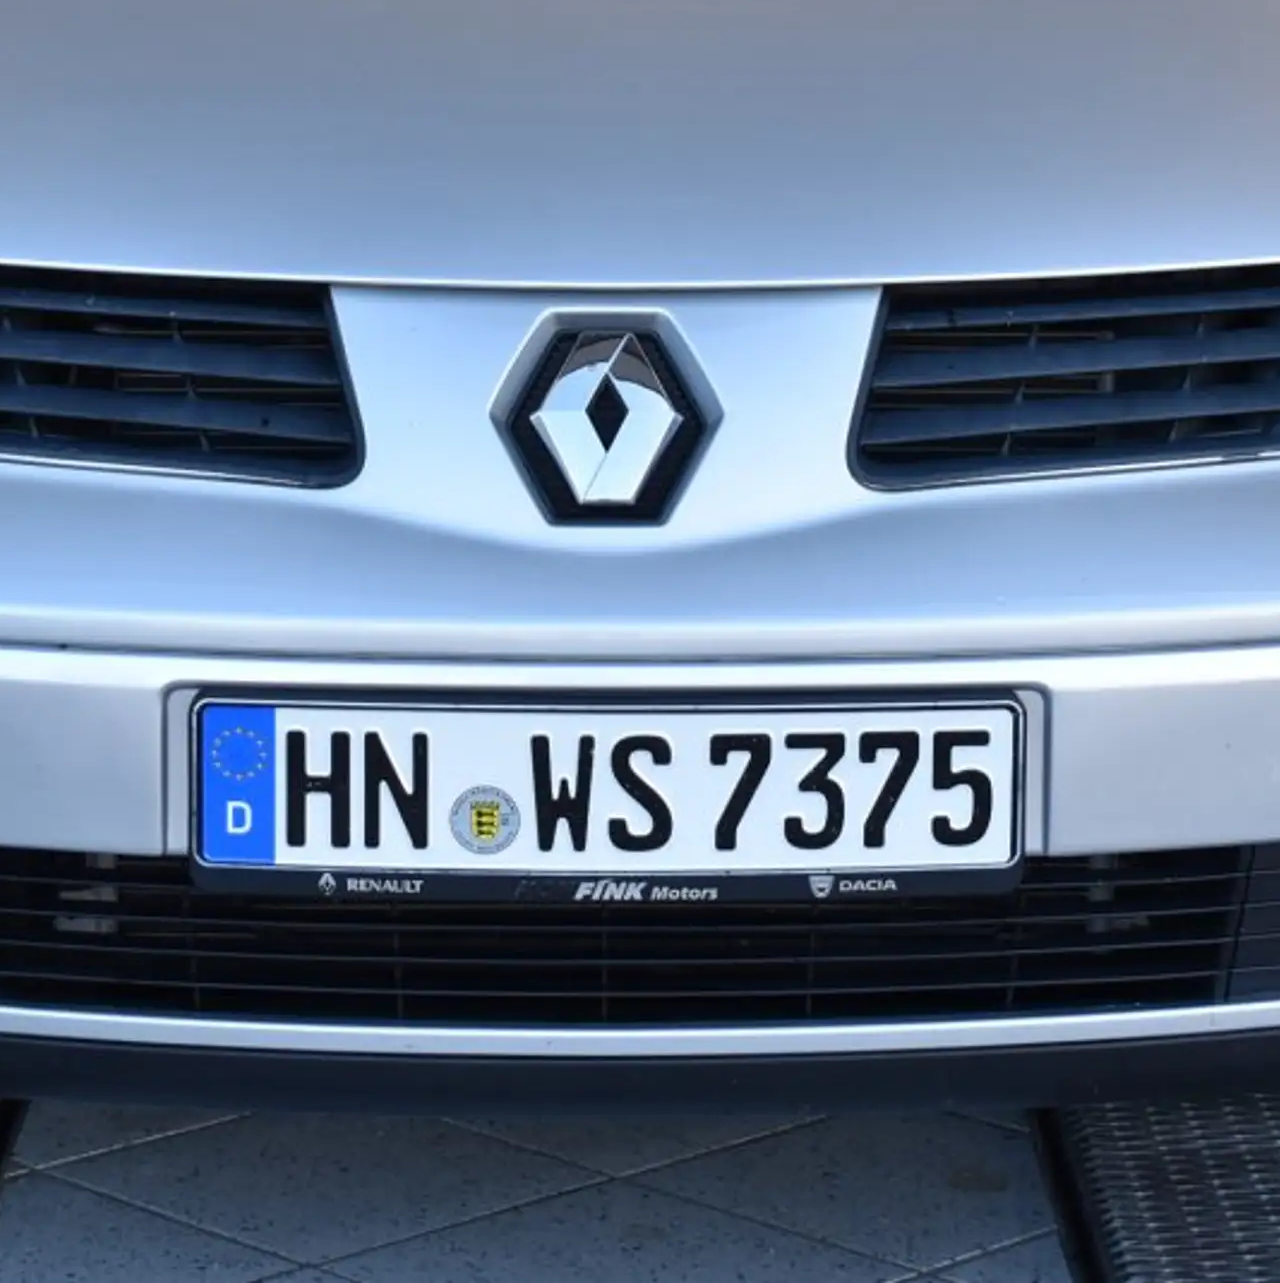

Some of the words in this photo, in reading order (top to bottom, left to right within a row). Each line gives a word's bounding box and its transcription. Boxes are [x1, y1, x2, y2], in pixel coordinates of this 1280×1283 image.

[285, 730, 429, 850] HN
[531, 732, 673, 852] WS
[710, 730, 992, 851] 7375
[225, 800, 252, 834] D
[346, 877, 424, 894] RENAULT
[650, 885, 718, 901] Motors
[838, 878, 898, 892] DACIA
